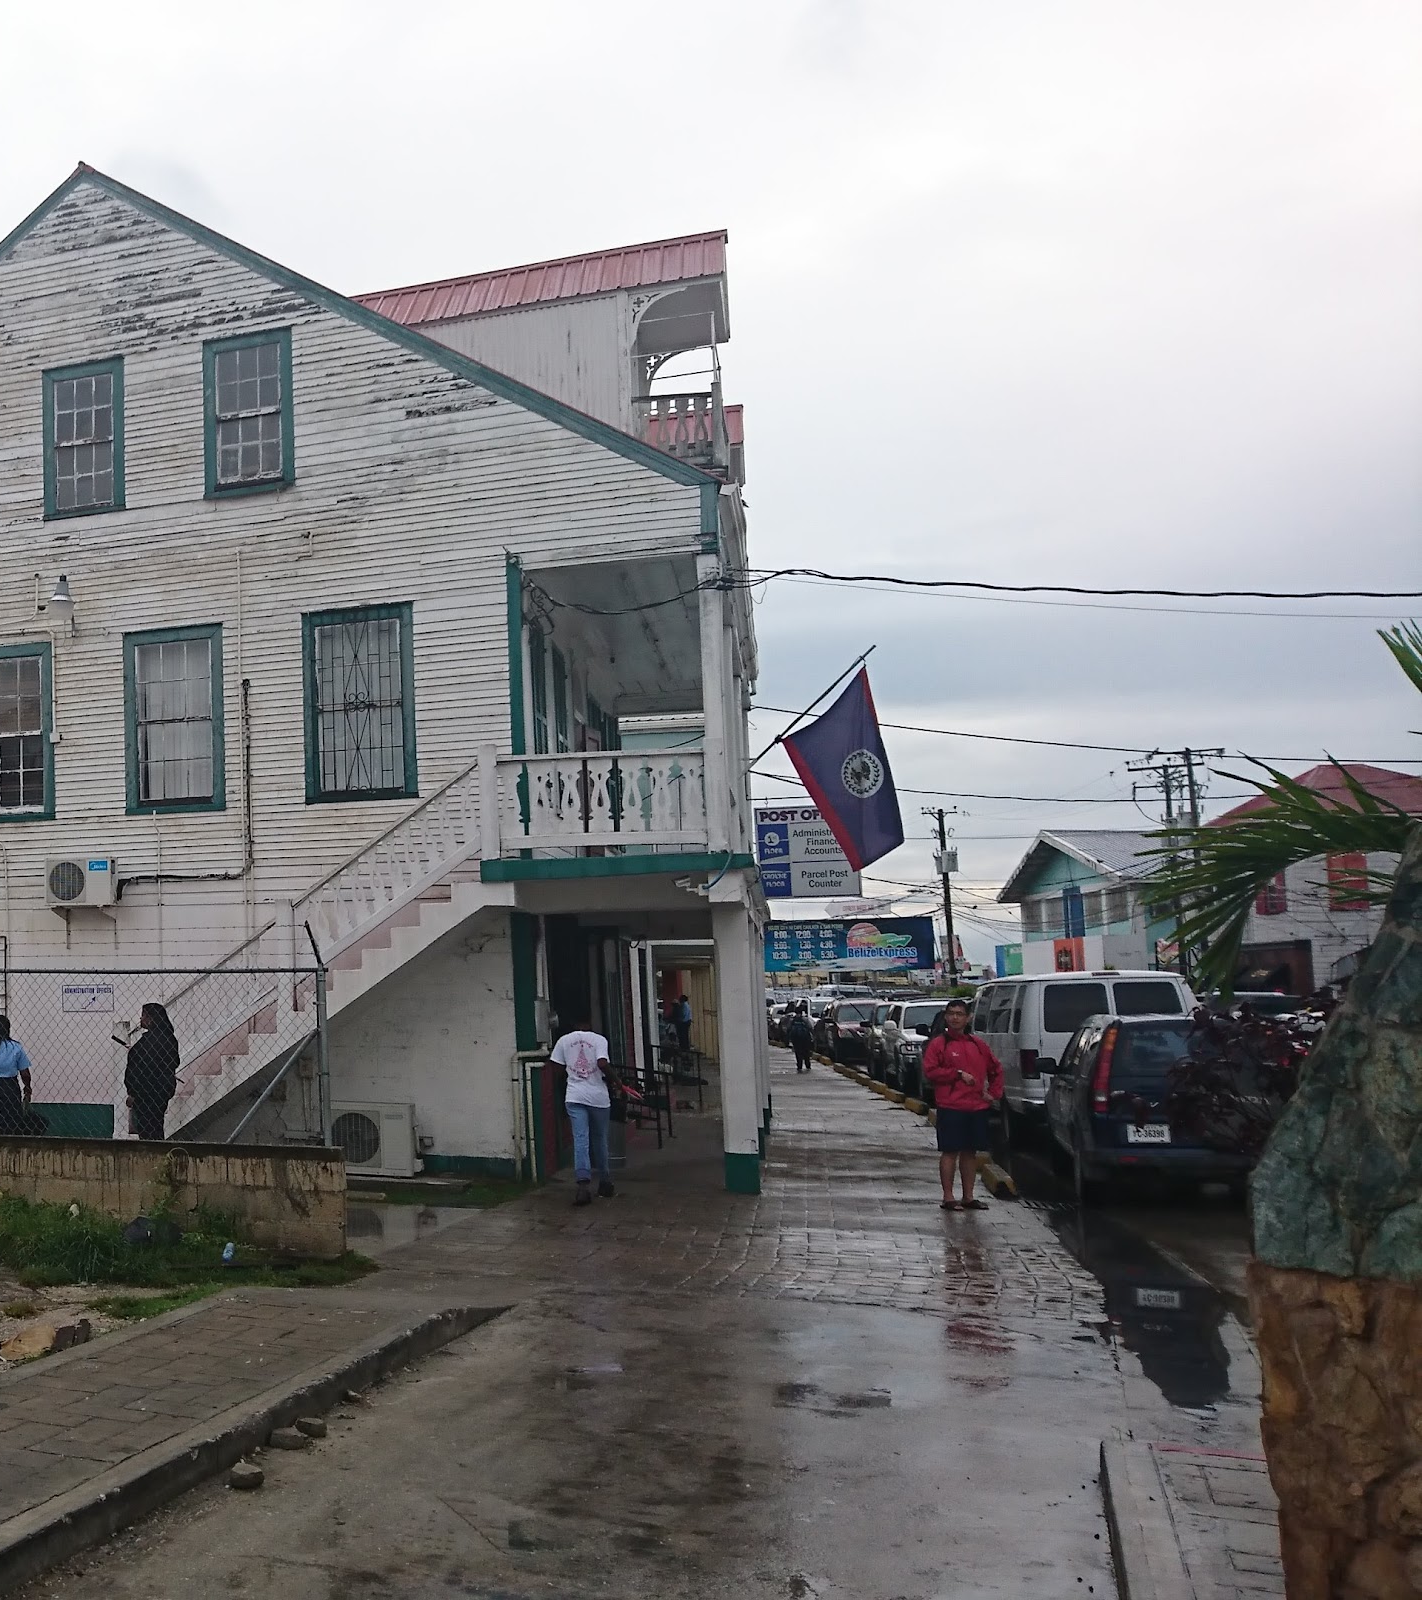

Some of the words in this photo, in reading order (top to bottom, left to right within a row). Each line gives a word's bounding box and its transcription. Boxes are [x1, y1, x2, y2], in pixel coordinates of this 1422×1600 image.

[759, 810, 798, 822] POST
[800, 809, 824, 820] OF
[764, 847, 783, 855] FLOOR
[804, 847, 843, 855] Accounts
[801, 870, 828, 879] Parcel
[829, 870, 849, 878] Post
[808, 880, 842, 888] Counter
[847, 947, 877, 958] Belize
[878, 947, 917, 958] Express
